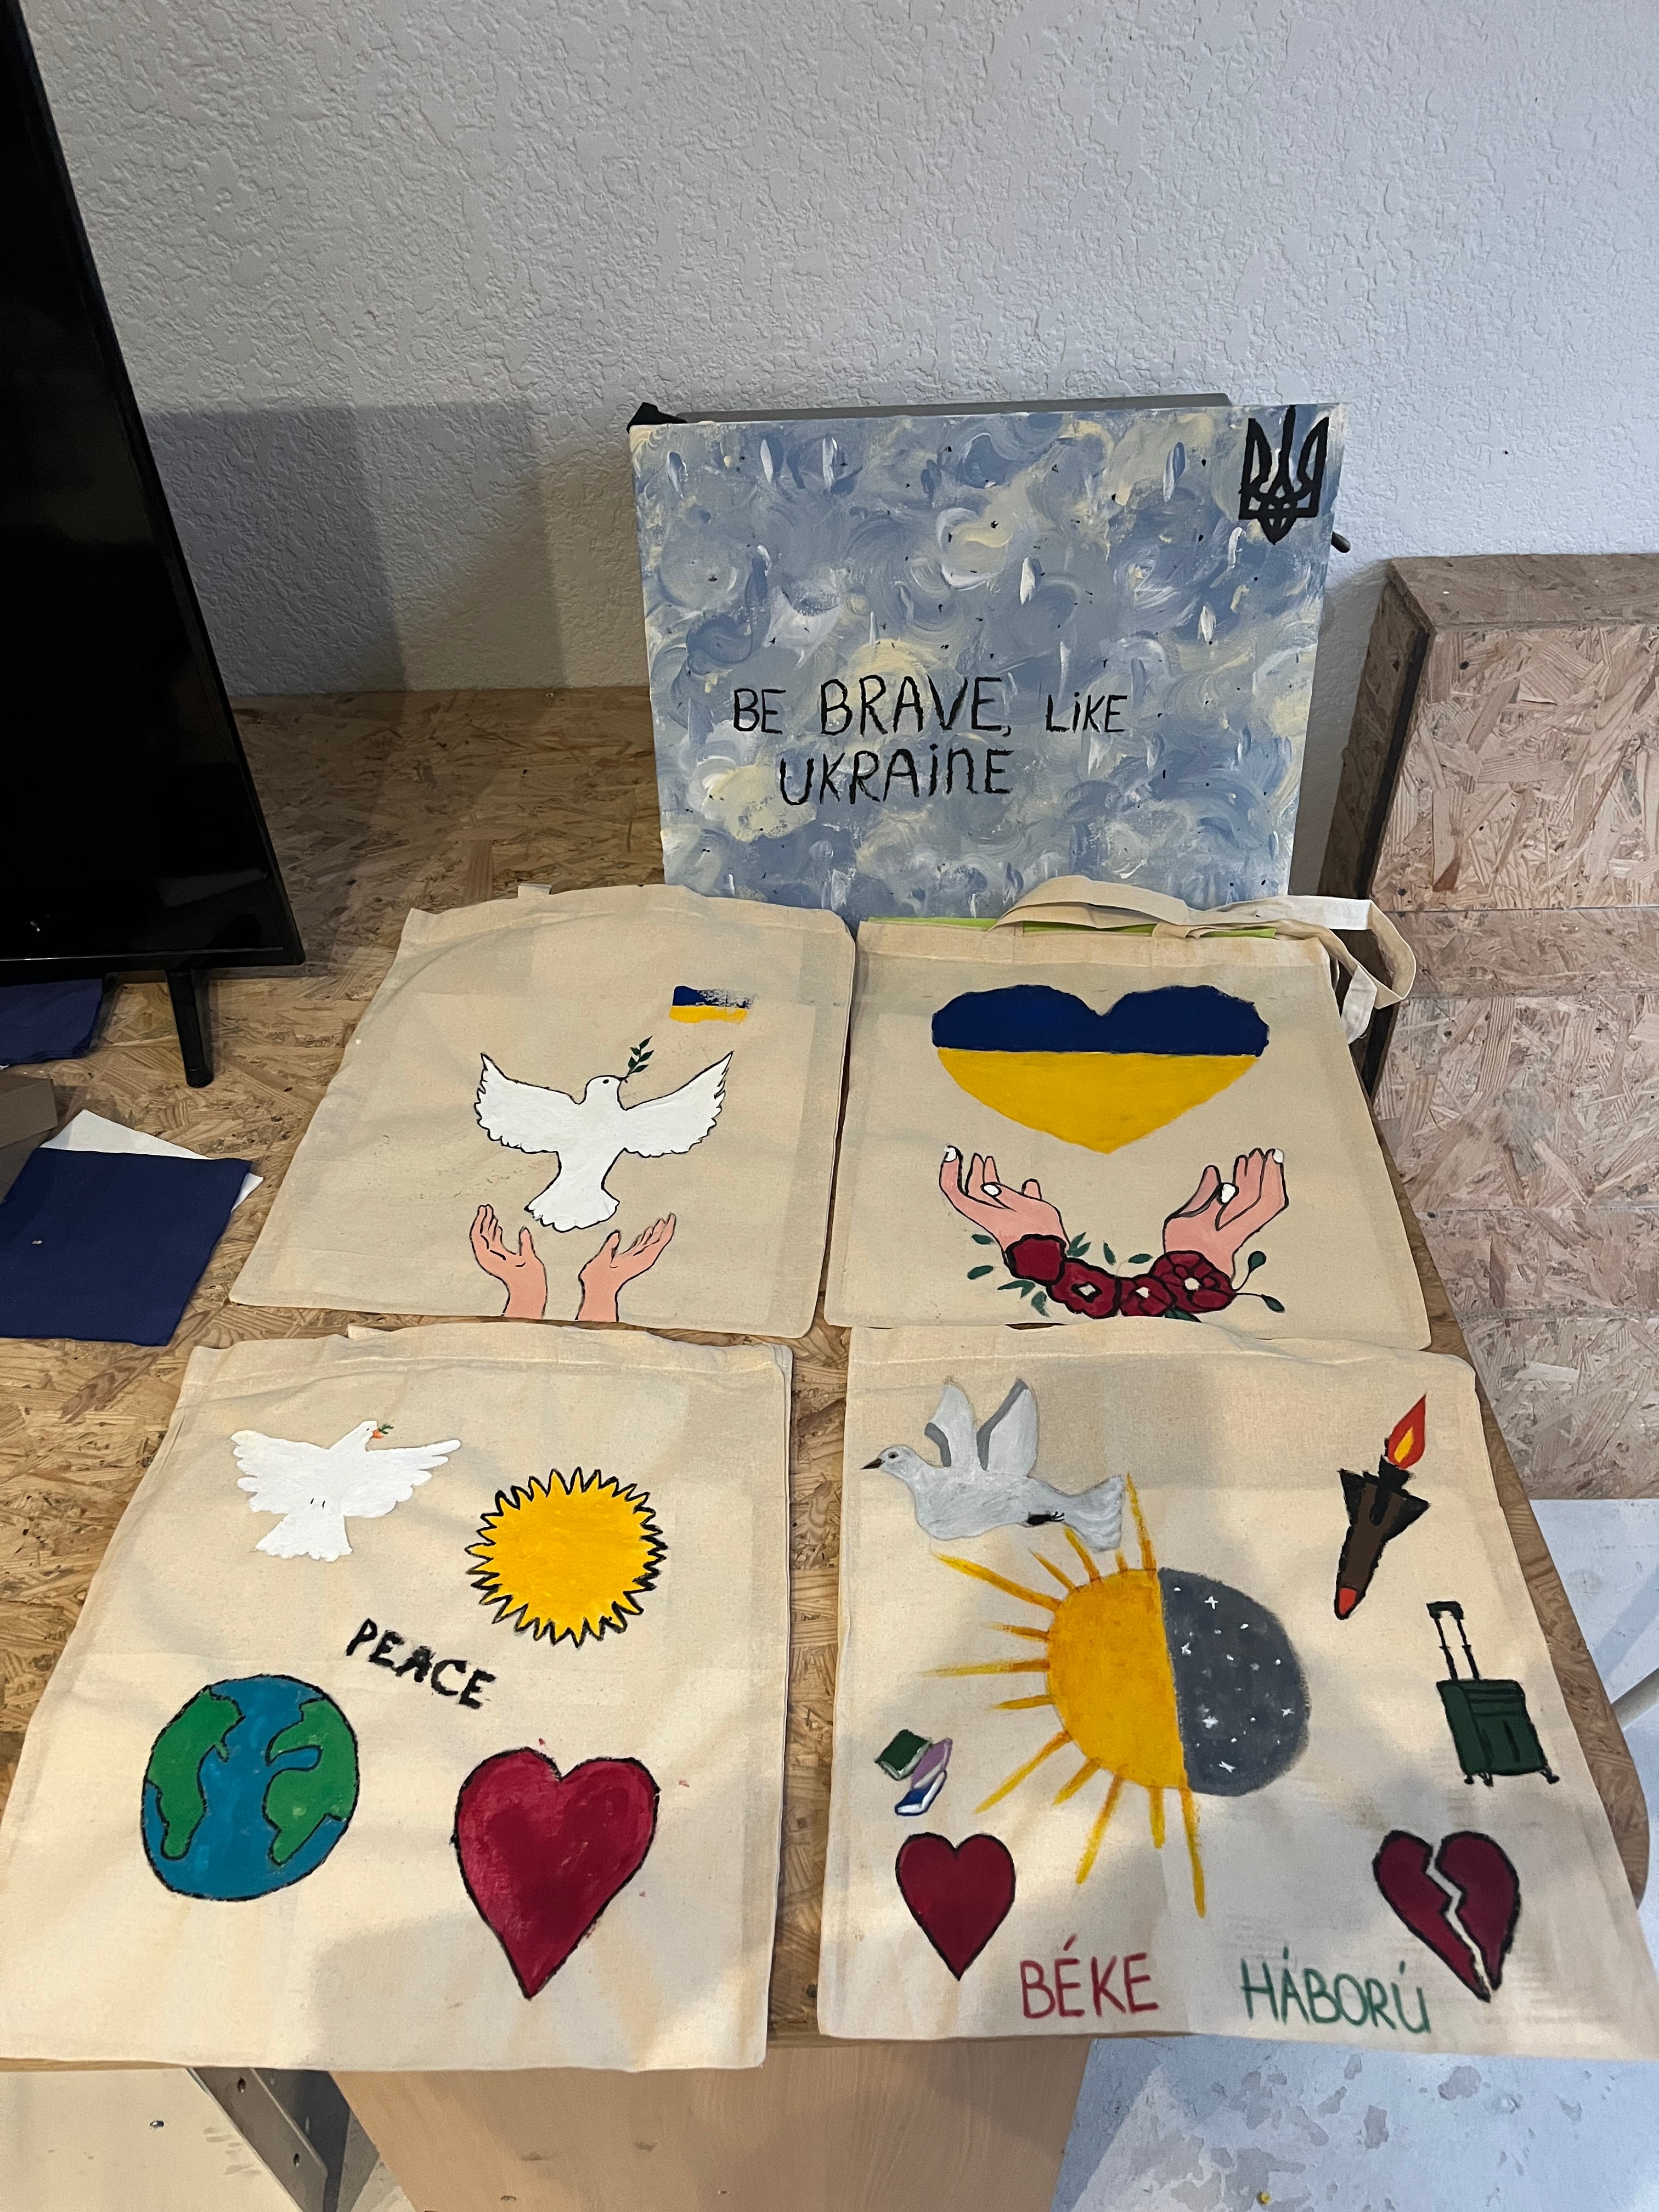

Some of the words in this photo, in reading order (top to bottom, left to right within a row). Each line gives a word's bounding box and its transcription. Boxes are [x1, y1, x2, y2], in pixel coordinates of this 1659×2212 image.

[733, 688, 786, 734] BE
[820, 674, 1012, 737] BRAVE,
[346, 1618, 496, 1709] PEACE
[1020, 1934, 1159, 2019] BÉKE
[1240, 1944, 1431, 2034] HÁBORÚ
